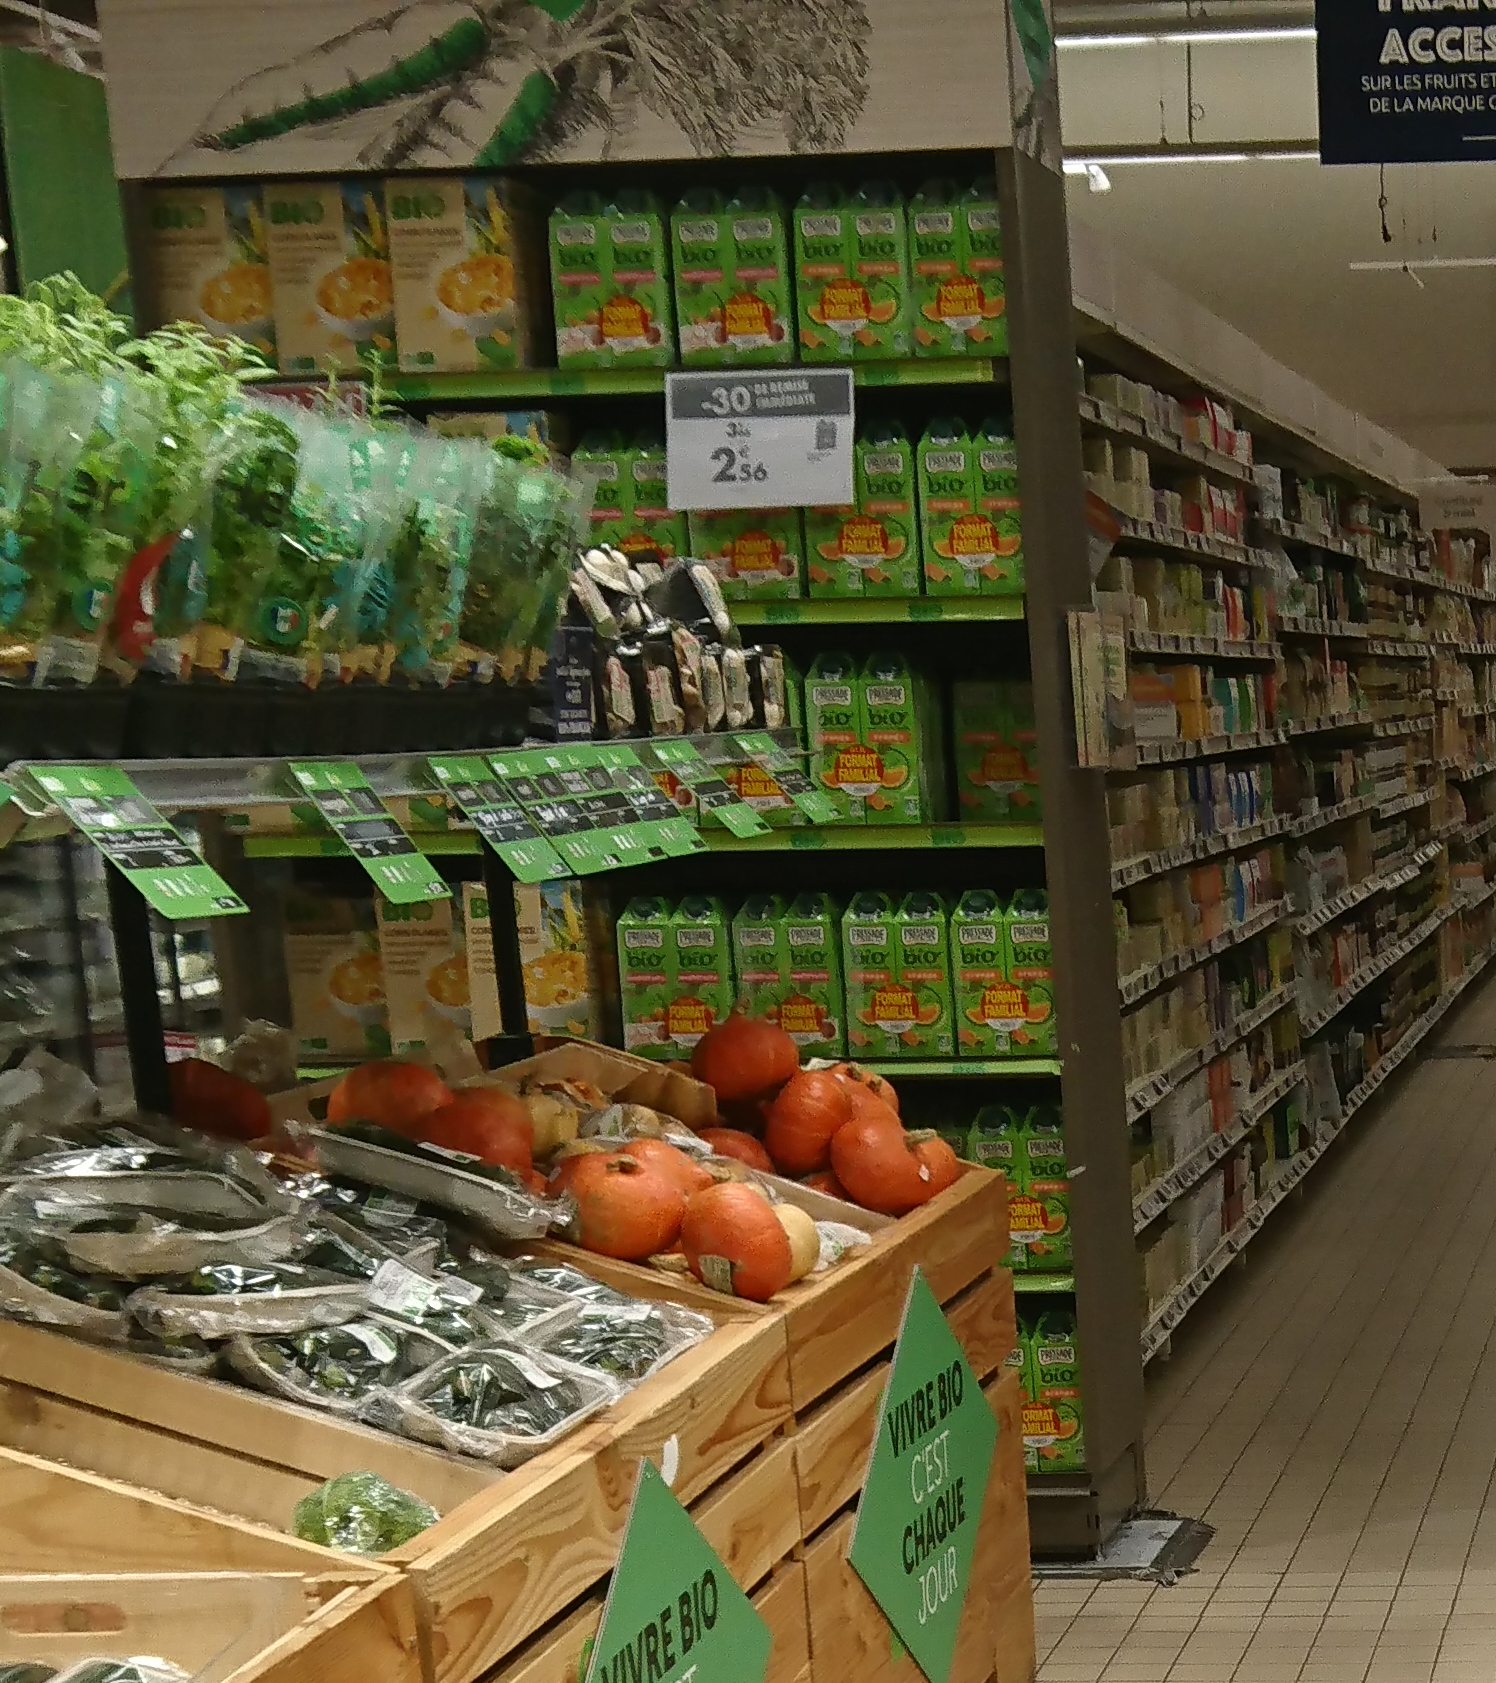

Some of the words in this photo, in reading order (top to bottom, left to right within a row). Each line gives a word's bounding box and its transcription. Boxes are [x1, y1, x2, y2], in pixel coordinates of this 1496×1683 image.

[1361, 74, 1392, 91] SUR
[1394, 73, 1421, 91] LES
[1425, 72, 1477, 90] FRUITS
[1481, 71, 1496, 89] ET
[1370, 97, 1390, 114] DE
[1394, 96, 1415, 112] LA
[1417, 94, 1484, 115] MARQUE
[839, 754, 878, 769] FORMAT
[838, 768, 882, 783] FAMILIAL
[875, 991, 914, 1006] FORMAT
[985, 990, 1024, 1005] FORMAT
[984, 1004, 1027, 1019] FAMILIAL
[886, 1378, 938, 1460] VIVRE
[937, 1359, 966, 1419] BIO
[909, 1430, 952, 1503] C'EST
[901, 1475, 967, 1576] CHAQUE
[917, 1545, 960, 1624] JOUR
[675, 1568, 719, 1667] BIO
